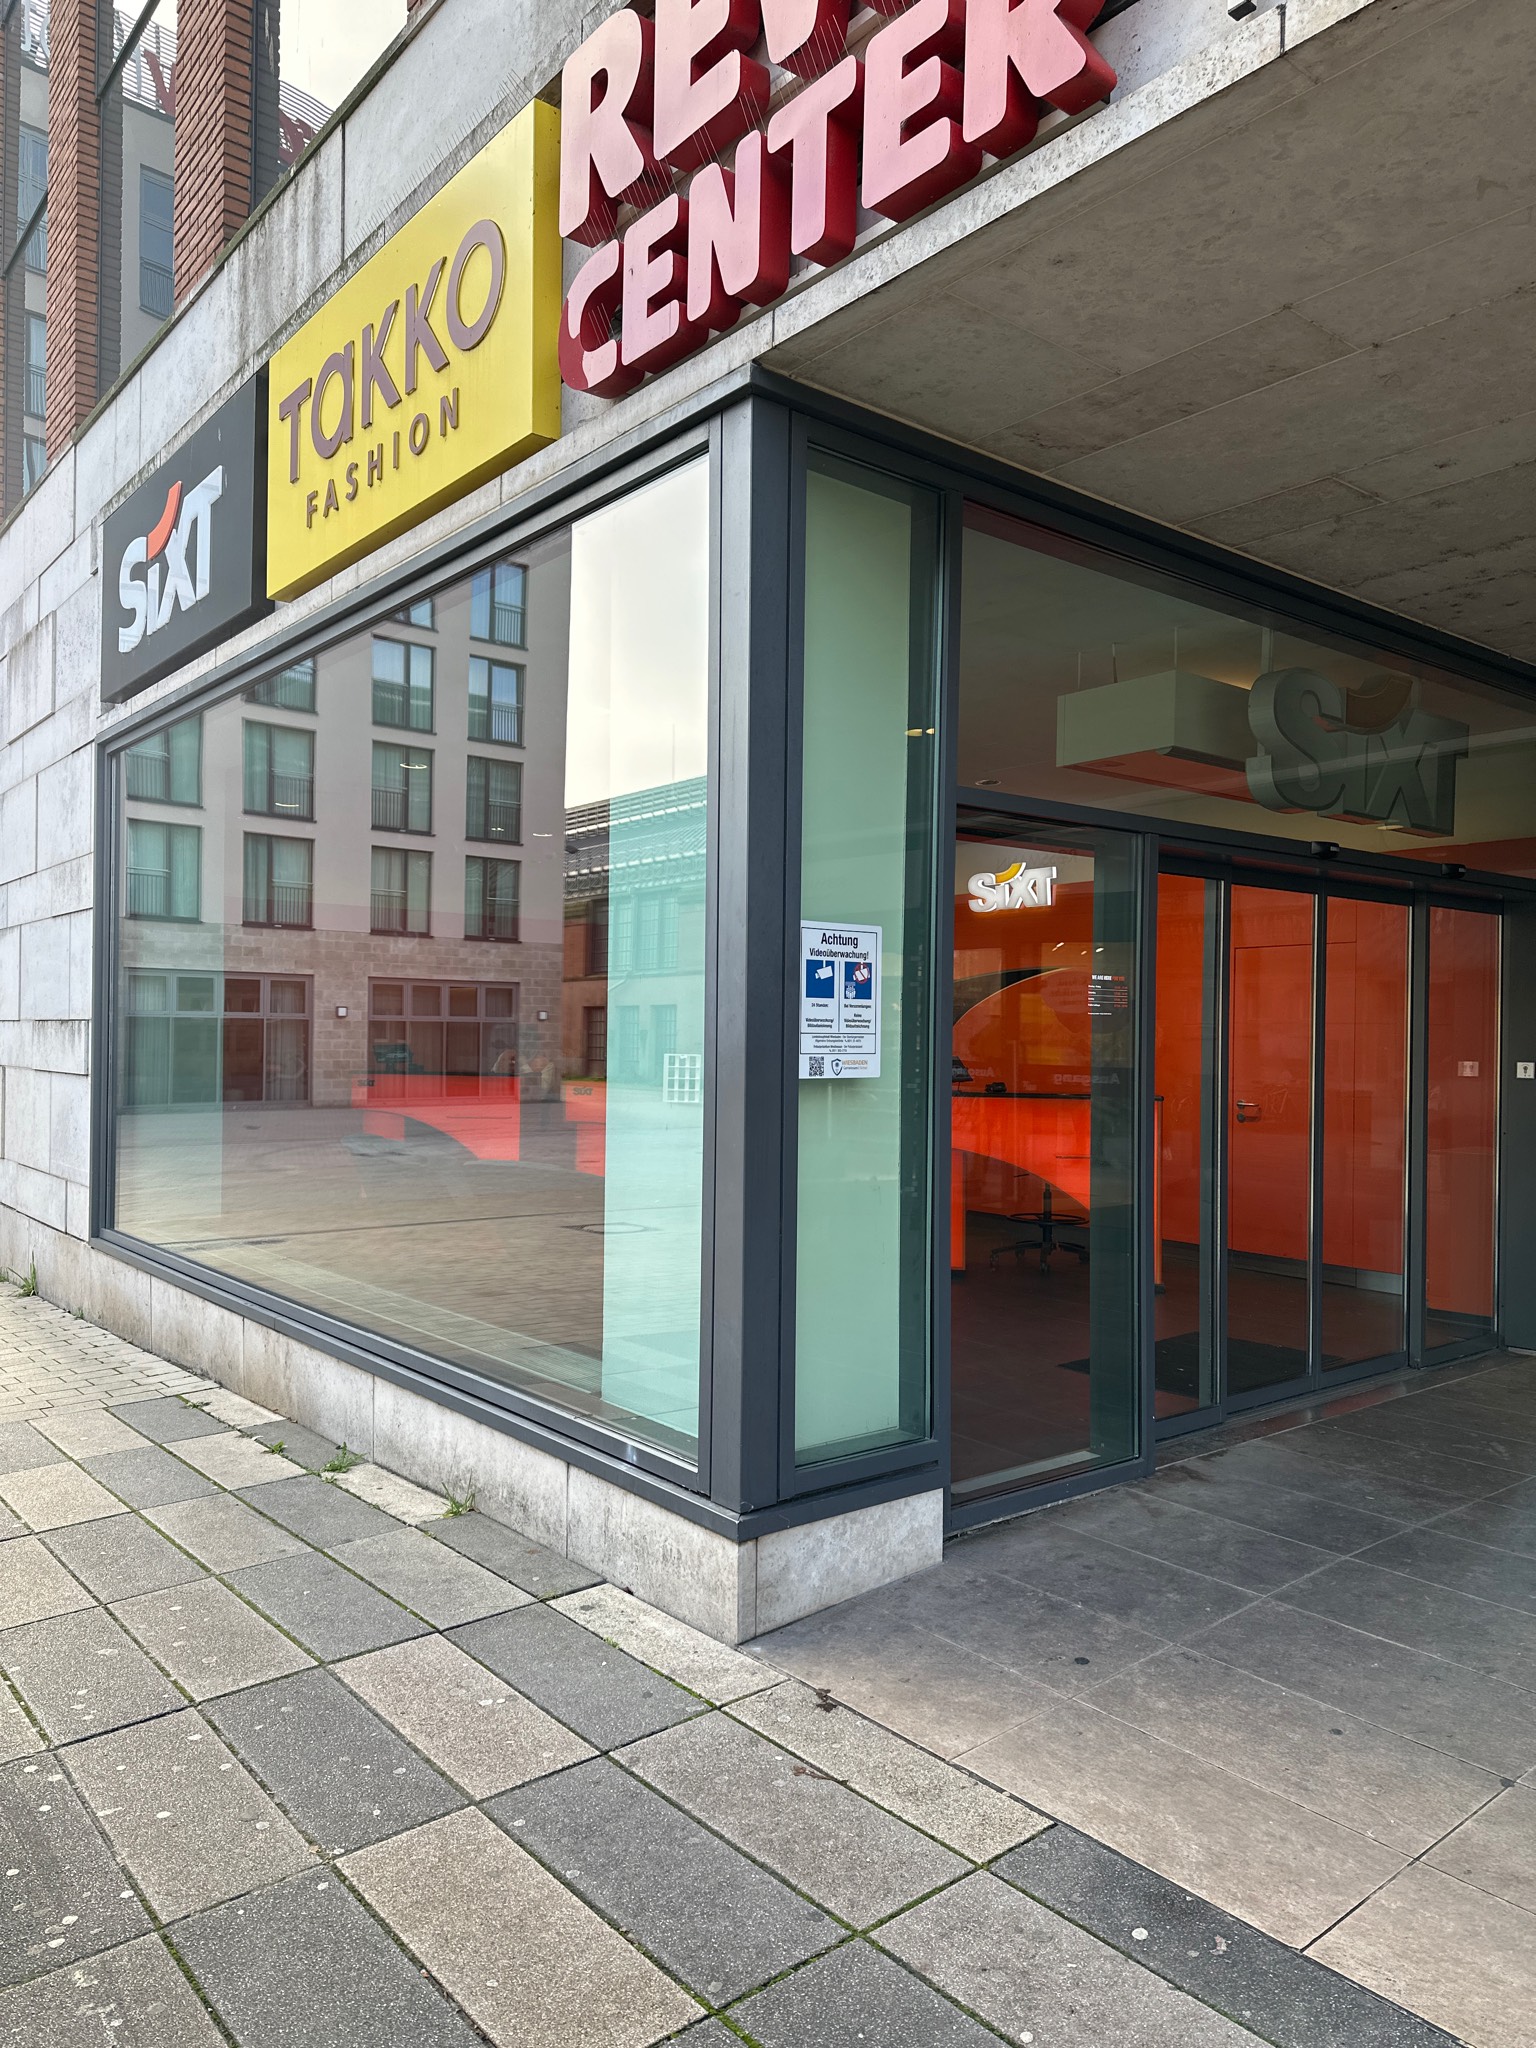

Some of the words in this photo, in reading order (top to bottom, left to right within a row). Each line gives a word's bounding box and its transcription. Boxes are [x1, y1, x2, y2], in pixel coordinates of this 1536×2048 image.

[306, 387, 460, 528] FASHION
[821, 932, 859, 949] Achtung
[809, 947, 869, 961] Videoüberwachung!
